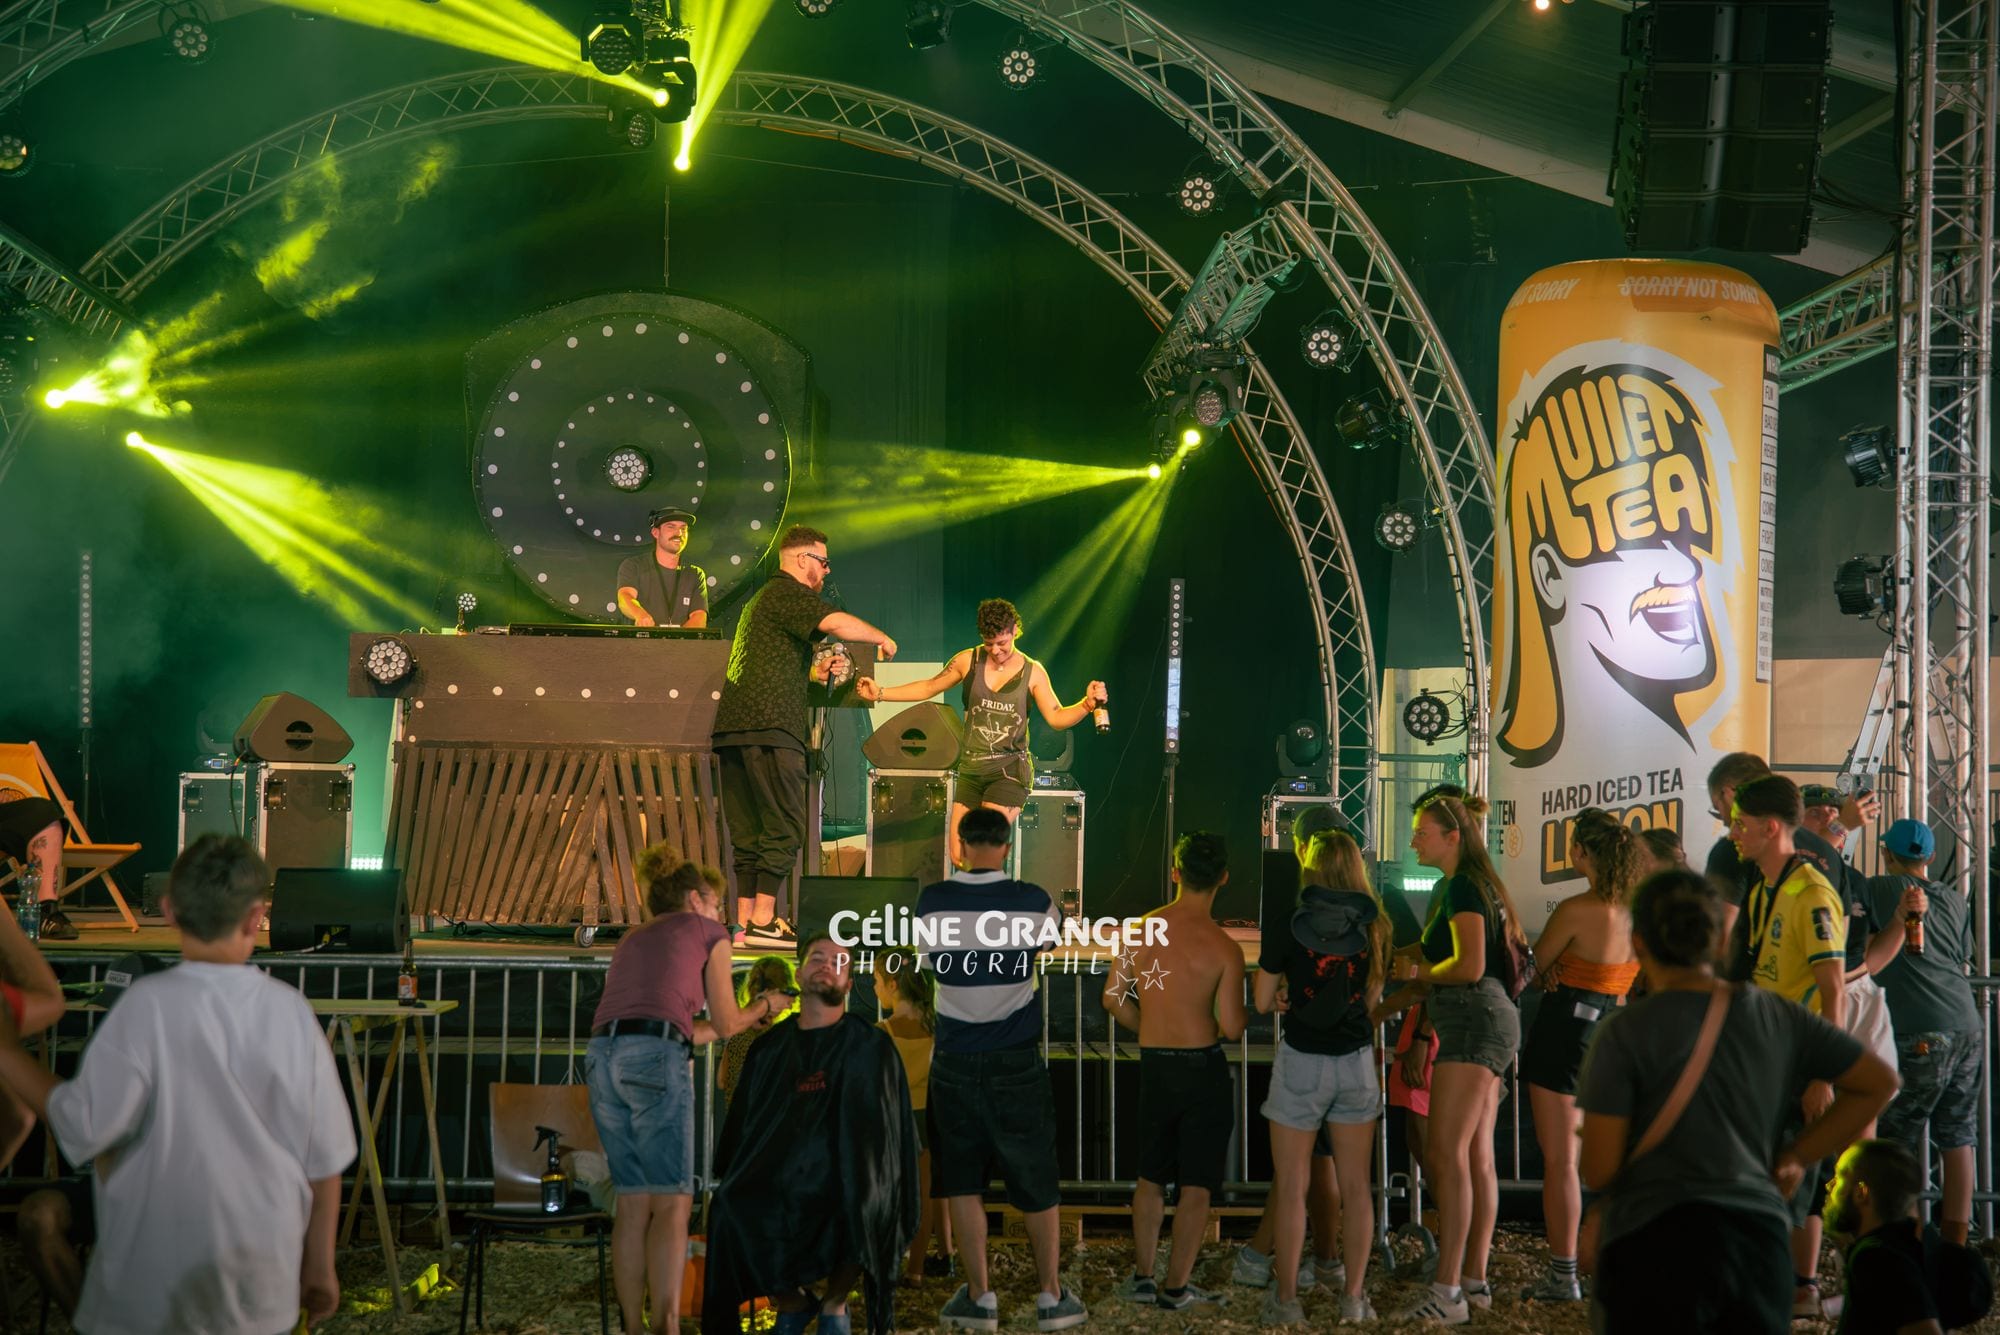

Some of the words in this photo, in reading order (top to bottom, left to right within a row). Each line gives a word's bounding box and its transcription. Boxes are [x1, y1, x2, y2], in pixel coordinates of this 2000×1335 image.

[1527, 278, 1580, 304] SORRY
[1618, 275, 1685, 297] SORRY
[1684, 277, 1719, 298] NOT
[1571, 453, 1708, 552] TEA
[1542, 783, 1592, 816] HARD
[1596, 775, 1642, 805] ICED
[1646, 767, 1684, 796] TEA
